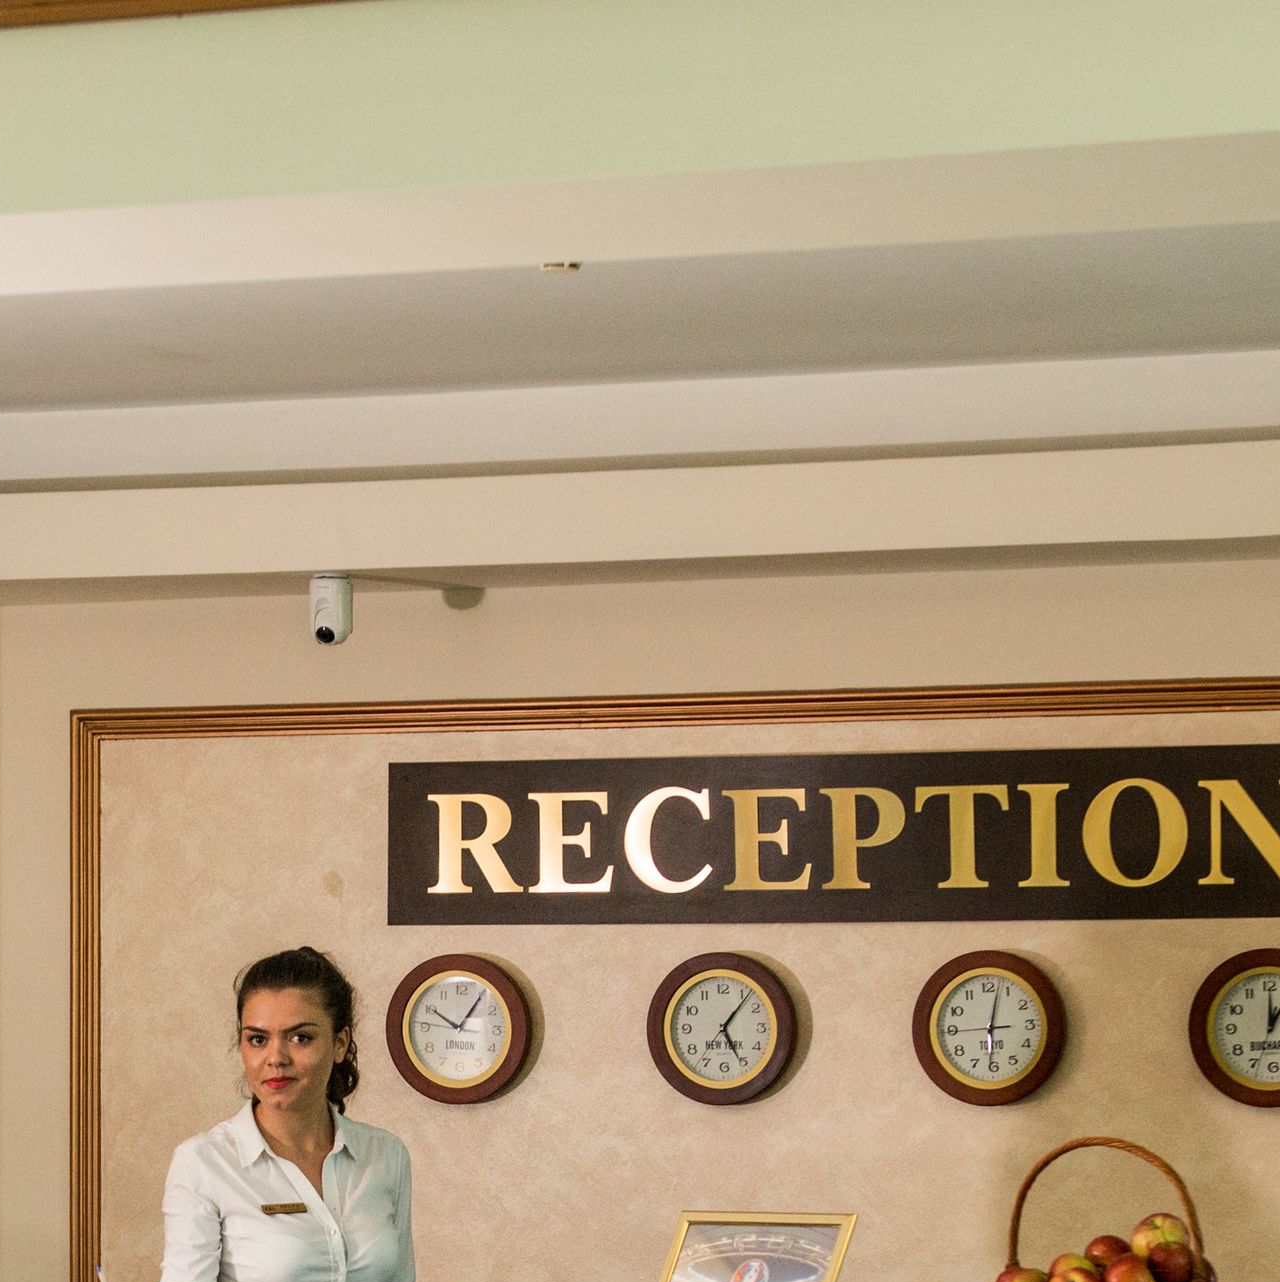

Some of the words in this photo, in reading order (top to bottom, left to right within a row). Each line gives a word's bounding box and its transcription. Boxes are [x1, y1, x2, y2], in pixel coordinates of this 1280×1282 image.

[456, 984, 468, 996] 12
[717, 984, 730, 994] 12
[982, 982, 995, 993] 12
[1006, 987, 1010, 997] 1
[1263, 981, 1277, 992] 12
[440, 990, 447, 1000] 11
[701, 990, 709, 1000] 11
[740, 989, 744, 1000] 1
[965, 990, 973, 1000] 11
[1245, 988, 1254, 999] 11
[425, 1004, 437, 1015] 10
[488, 1005, 497, 1016] 2
[686, 1005, 698, 1016] 10
[751, 1003, 760, 1013] 2
[1018, 1000, 1028, 1010] 2
[1230, 1004, 1243, 1015] 10
[951, 1005, 964, 1017] 10
[421, 1022, 430, 1032] 9
[681, 1023, 692, 1034] 9
[756, 1022, 767, 1033] 3
[1025, 1019, 1035, 1030] 3
[1225, 1023, 1237, 1035] 9
[492, 1025, 502, 1036] 3
[947, 1025, 958, 1036] 9
[425, 1042, 434, 1053] 8
[445, 1040, 475, 1050] LONDON
[487, 1043, 496, 1053] 4
[705, 1040, 721, 1050] NEW
[752, 1041, 761, 1051] 4
[979, 1040, 1004, 1050] TOYO
[1021, 1038, 1031, 1048] 4
[687, 1043, 698, 1055] 8
[954, 1045, 965, 1056] 8
[1232, 1044, 1244, 1056] 8
[702, 1057, 711, 1068] 7
[739, 1057, 749, 1067] 5
[970, 1058, 979, 1068] 7
[1008, 1055, 1018, 1065] 5
[1249, 1058, 1259, 1069] 7
[455, 1062, 464, 1072] 6
[719, 1062, 730, 1073] 6
[988, 1061, 1000, 1073] 6
[1267, 1062, 1279, 1073] 6
